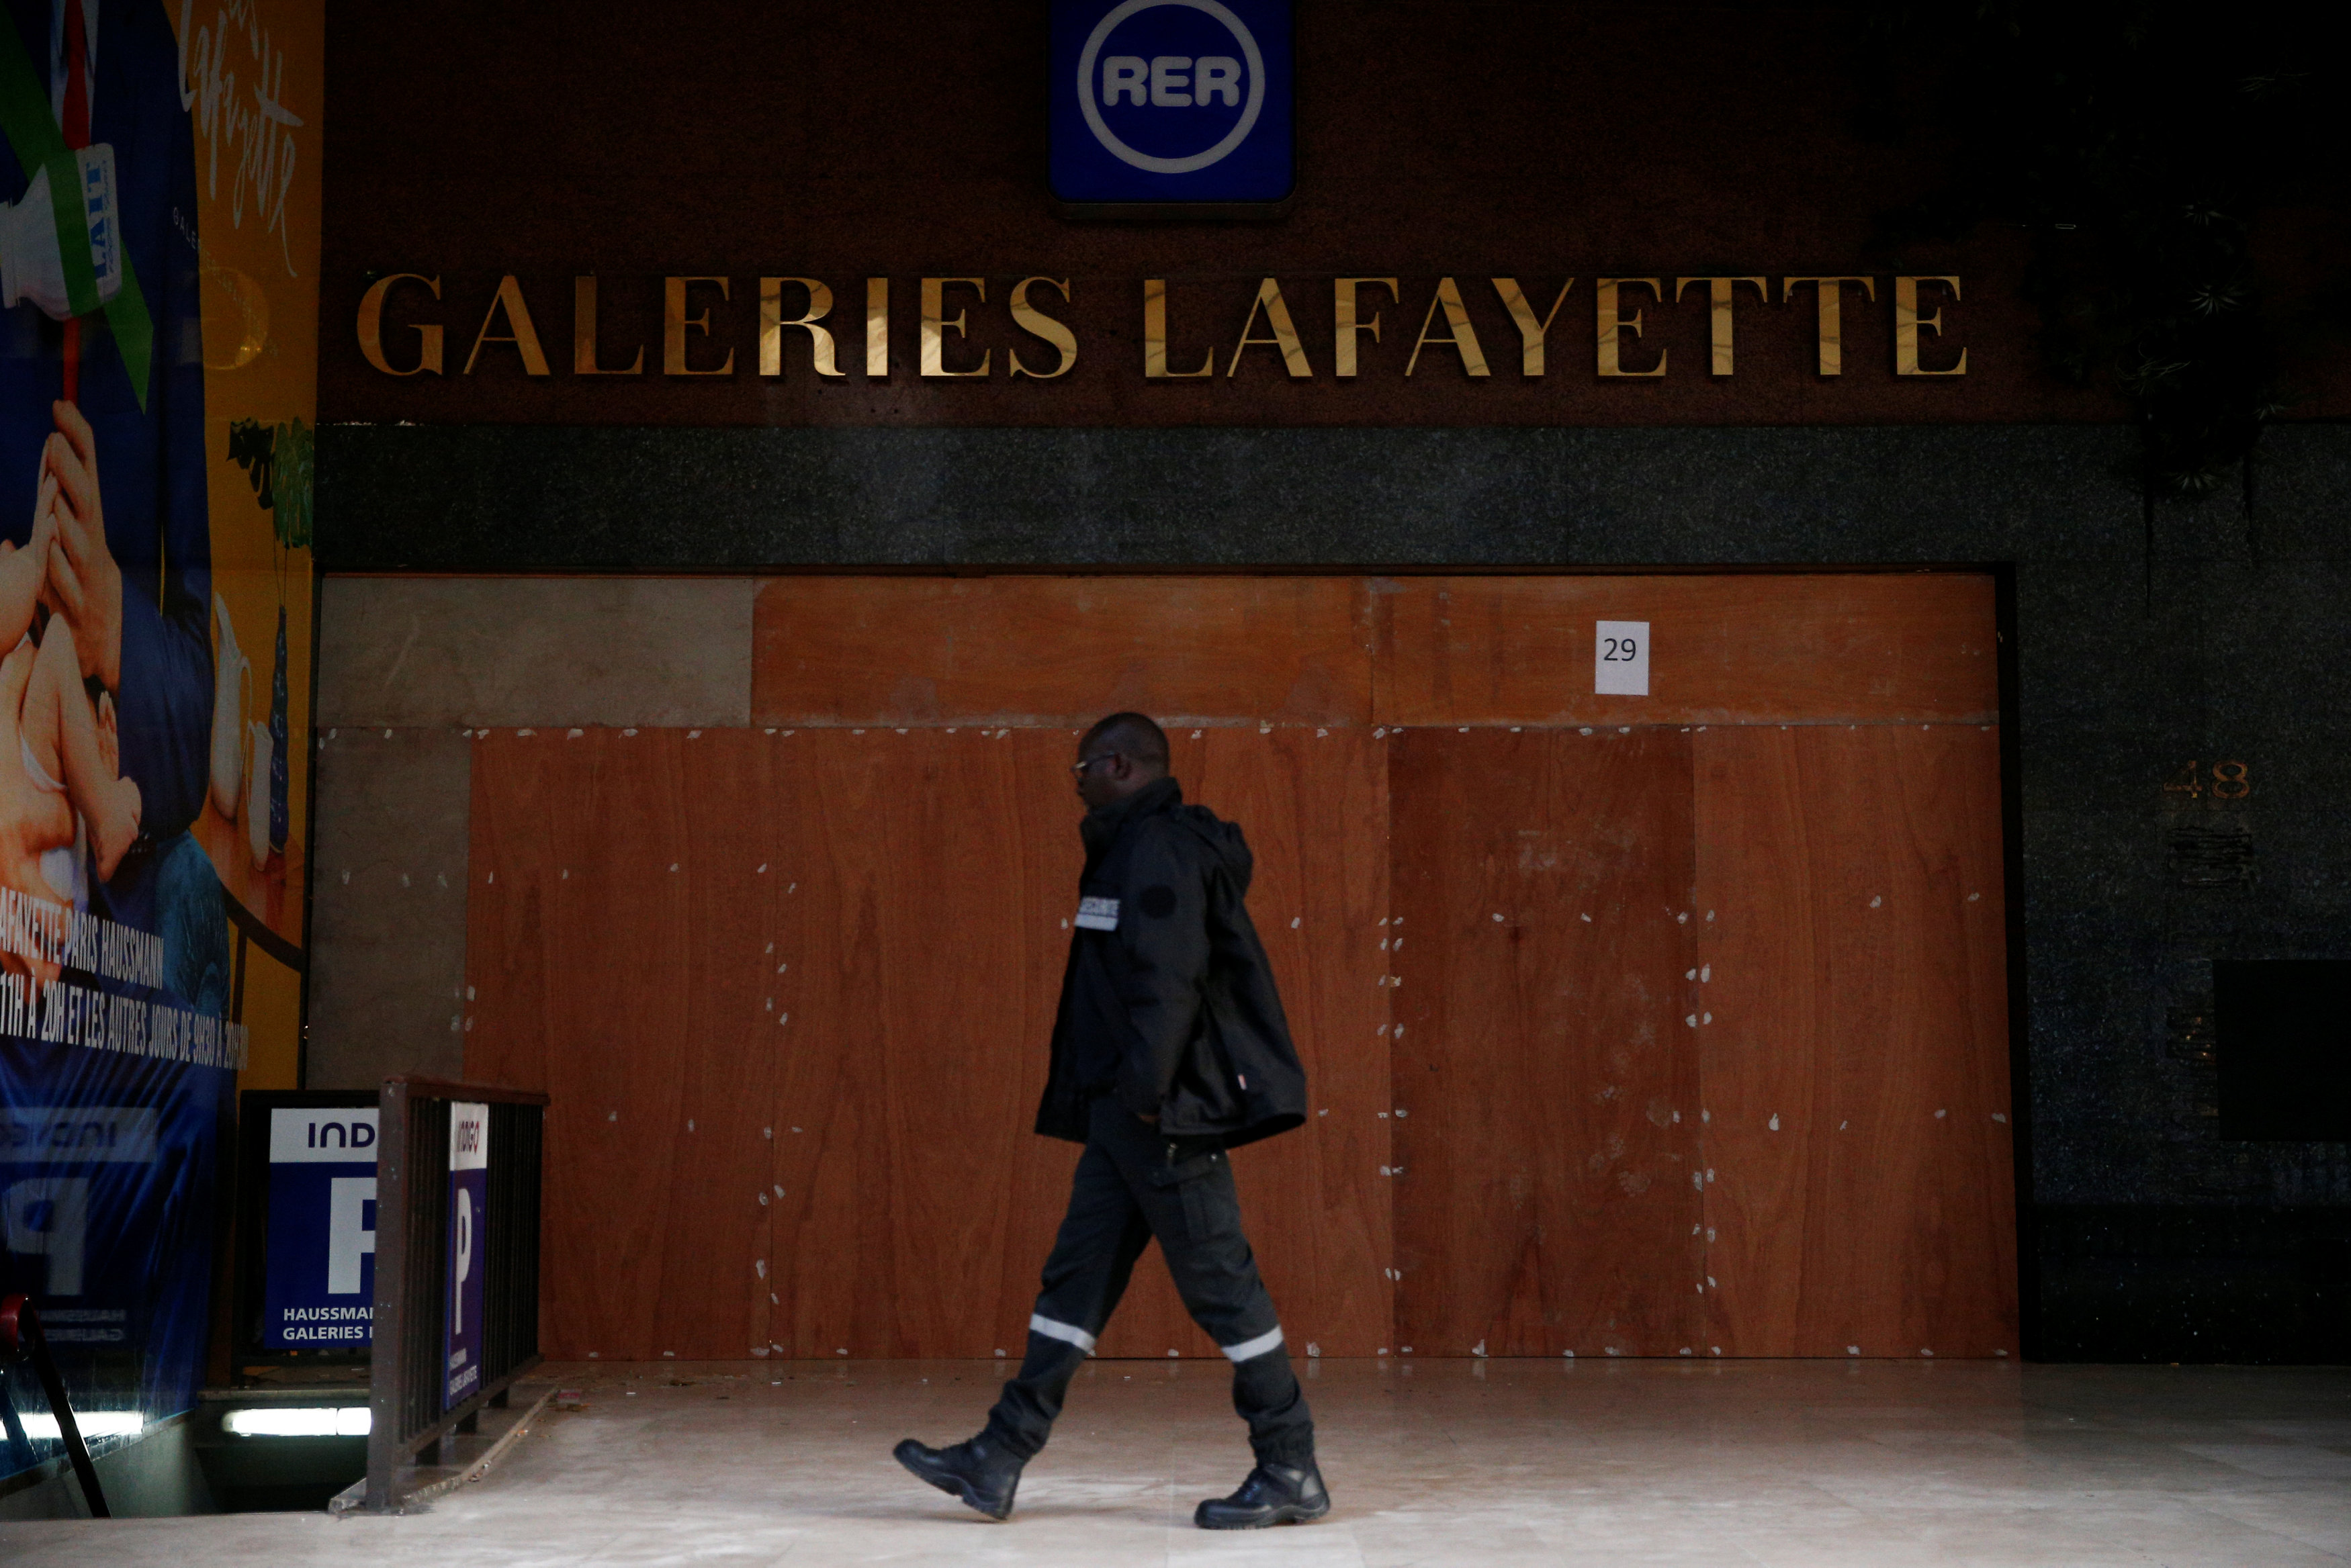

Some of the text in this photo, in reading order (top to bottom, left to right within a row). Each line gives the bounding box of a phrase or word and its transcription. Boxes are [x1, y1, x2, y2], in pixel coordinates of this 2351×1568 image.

[1102, 56, 1241, 107] RER
[357, 272, 1077, 378] GALERIES
[1144, 276, 1967, 378] LAFAYETTE
[1603, 638, 1636, 661] 29
[2162, 759, 2250, 798] 48
[64, 907, 98, 974] PARIS
[101, 919, 164, 990] HAUSSMANN
[41, 978, 66, 1042] 20H
[67, 985, 83, 1045] ET
[85, 988, 105, 1050] LES
[107, 994, 146, 1056] AUTRES
[148, 1004, 178, 1060] JOURS
[180, 1010, 192, 1062] DE
[193, 1013, 215, 1066] 9H30
[455, 1188, 472, 1335] P
[283, 1326, 363, 1340] GALERIES
